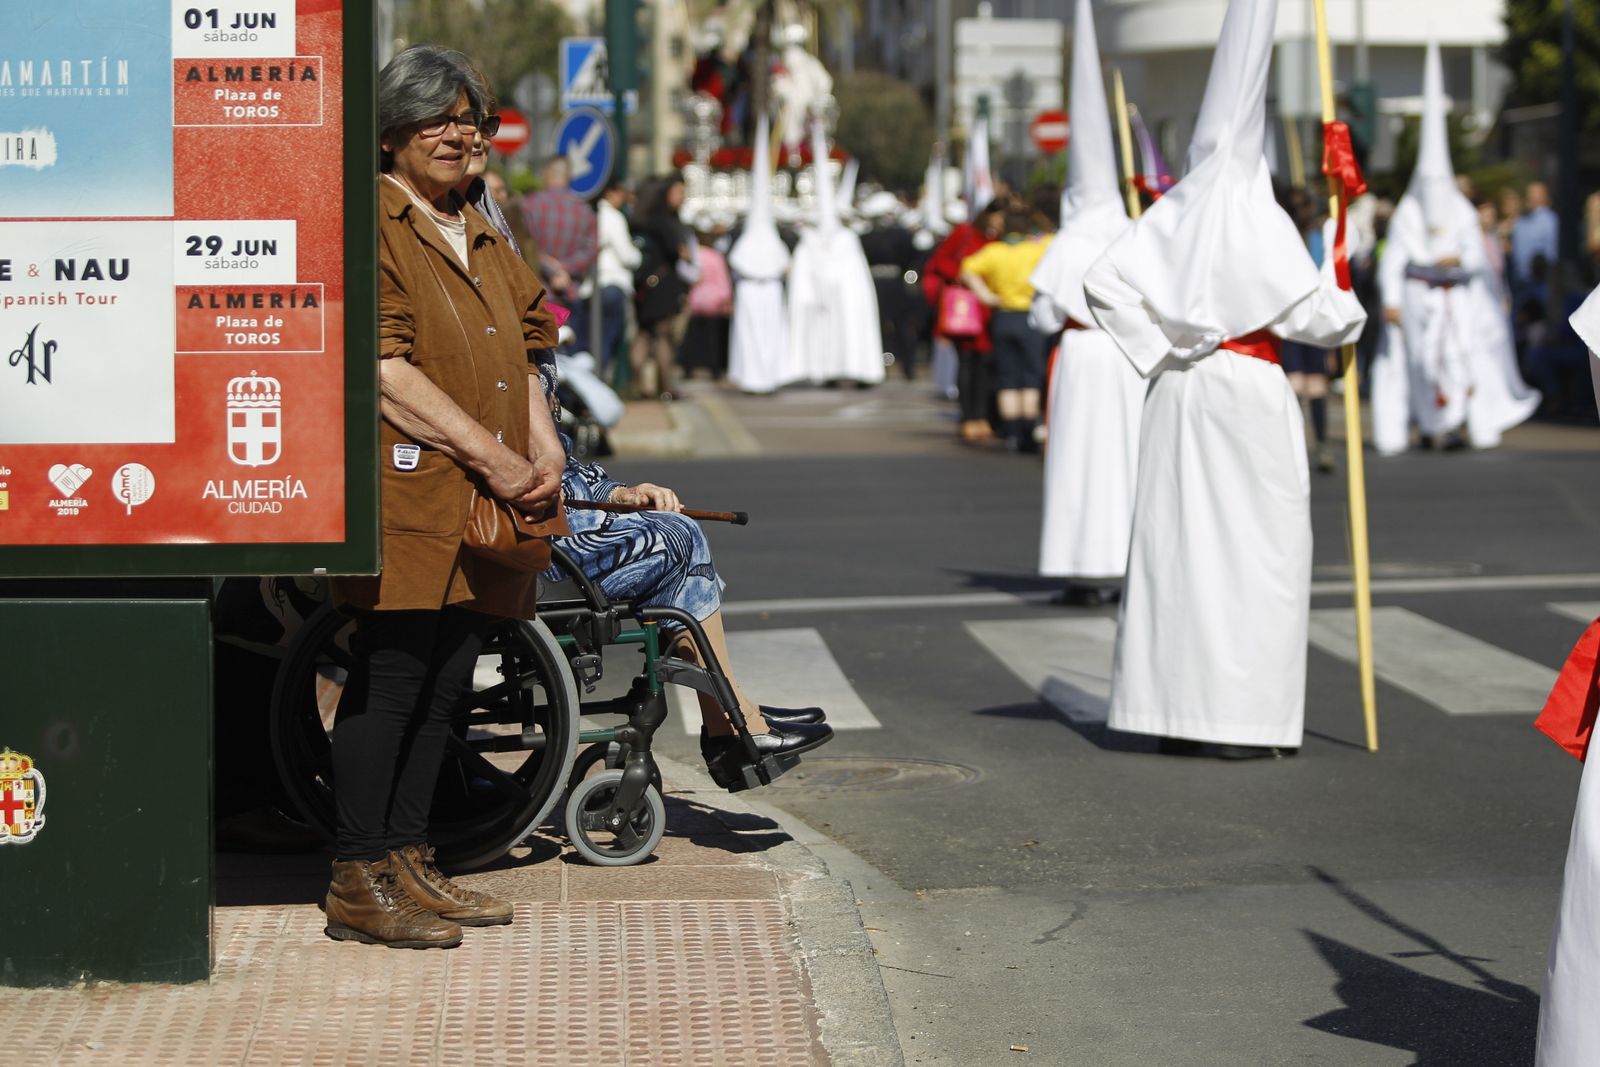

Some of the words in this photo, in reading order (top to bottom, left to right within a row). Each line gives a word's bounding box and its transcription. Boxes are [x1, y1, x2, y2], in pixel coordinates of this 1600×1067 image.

[184, 8, 219, 30] 01
[230, 13, 277, 29] JUN
[203, 28, 258, 42] sábado
[1, 56, 128, 86] AMARTÍN
[186, 64, 317, 83] ALMERÍA
[21, 87, 41, 96] QUE
[47, 87, 93, 96] HABITAN
[98, 87, 110, 96] EN
[214, 88, 256, 101] Plaza
[262, 88, 282, 101] de
[223, 105, 279, 118] TOROS
[185, 235, 223, 257] 29
[231, 240, 278, 256] JUN
[27, 263, 40, 278] &
[54, 258, 130, 281] NAU
[204, 256, 259, 270] sábado
[0, 291, 68, 309] panish
[75, 292, 118, 305] Tour
[187, 289, 319, 309] ALMERÍA
[216, 315, 258, 328] Plaza
[264, 315, 283, 328] de
[225, 332, 280, 345] TOROS
[202, 475, 308, 499] ALMERÍA
[48, 498, 88, 507] ALMERÍA
[228, 502, 282, 514] CIUDAD
[57, 508, 79, 516] 2019
